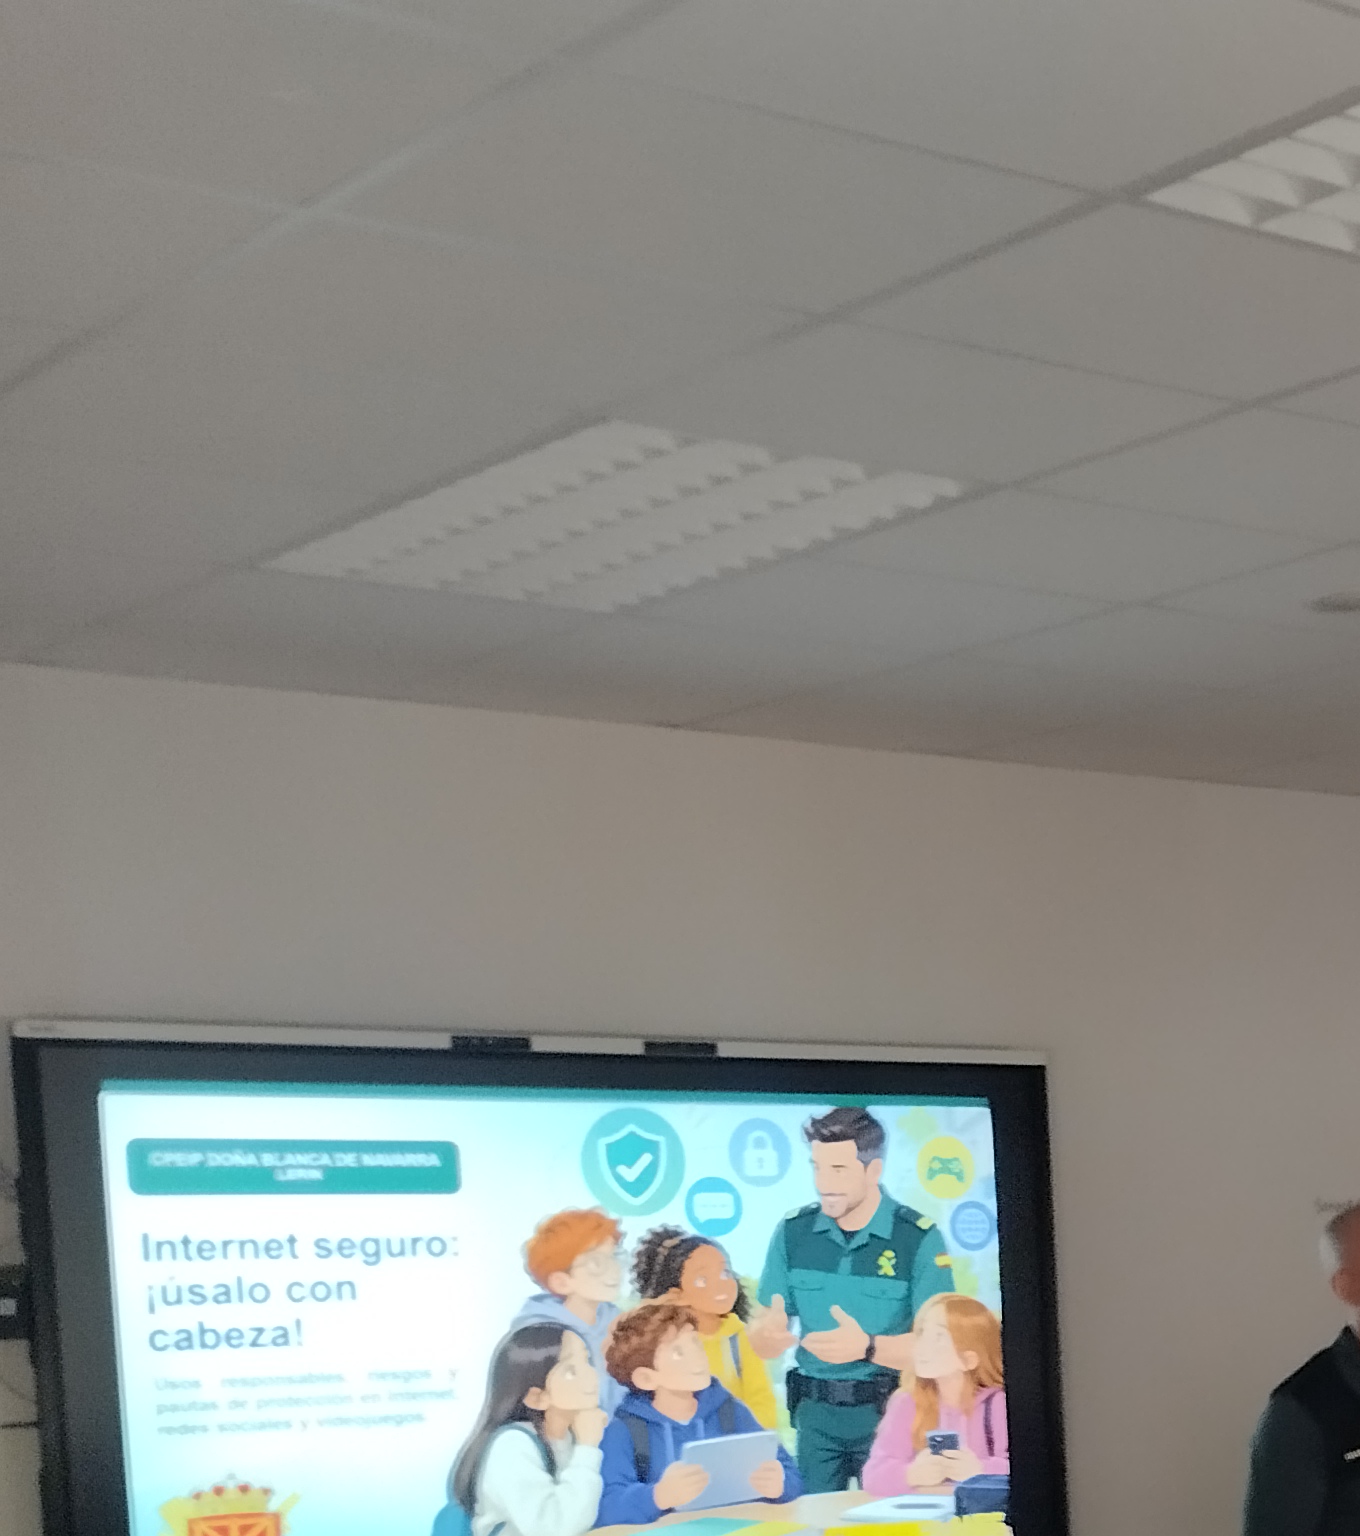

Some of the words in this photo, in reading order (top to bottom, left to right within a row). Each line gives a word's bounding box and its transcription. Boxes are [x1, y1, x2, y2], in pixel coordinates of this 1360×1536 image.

[205, 1148, 259, 1167] DOÑA
[260, 1151, 333, 1167] BLANCA
[334, 1152, 358, 1167] DE
[361, 1152, 442, 1167] NAVARRA
[142, 1232, 300, 1262] Internet
[313, 1235, 459, 1266] seguro:
[148, 1276, 271, 1314] ¡úsalo
[286, 1280, 357, 1303] con
[149, 1317, 303, 1351] cabeza!
[228, 1398, 248, 1410] de
[157, 1423, 210, 1435] redes
[216, 1418, 293, 1434] sociales
